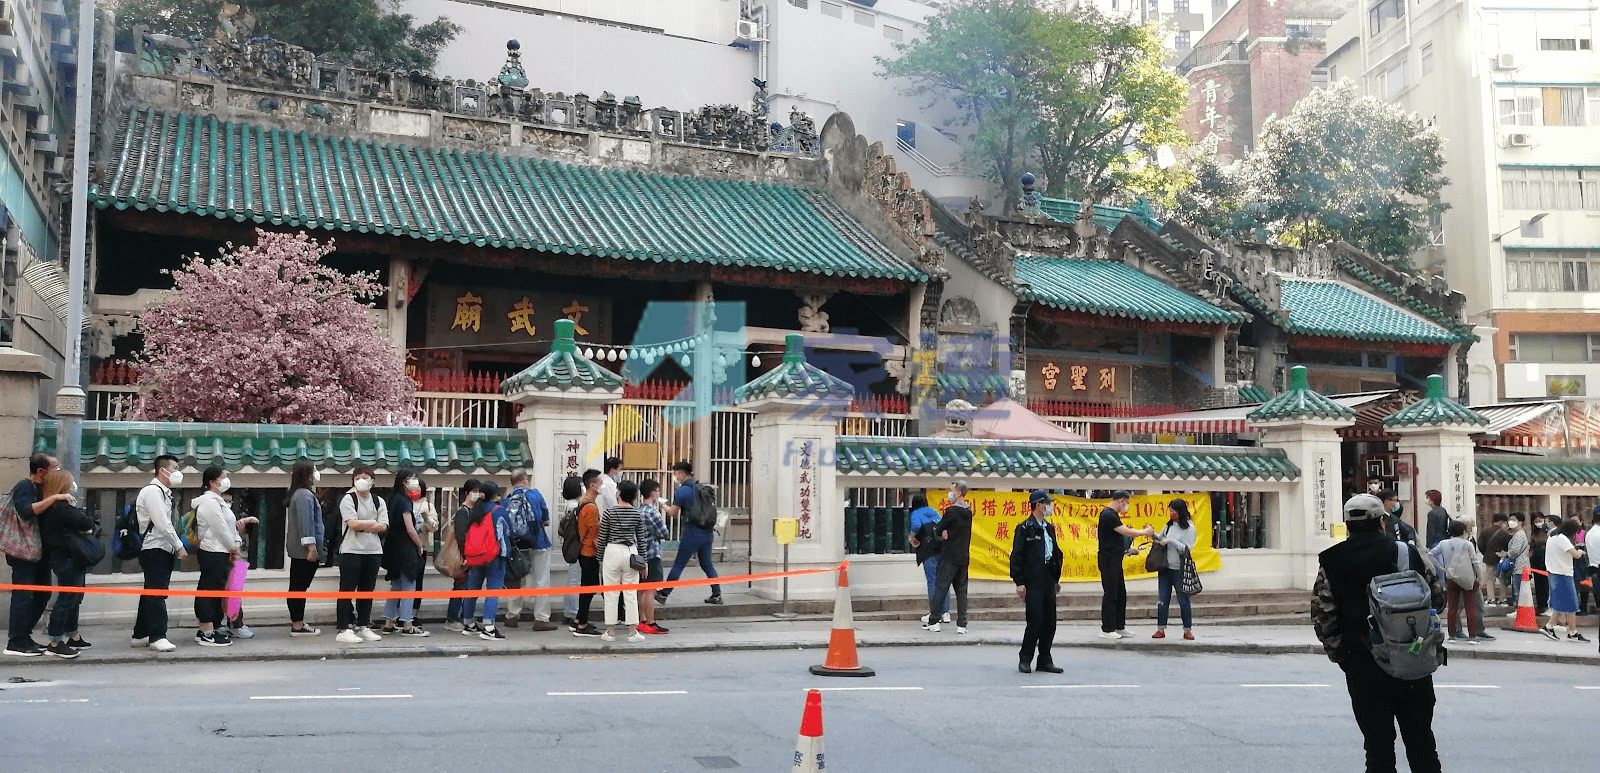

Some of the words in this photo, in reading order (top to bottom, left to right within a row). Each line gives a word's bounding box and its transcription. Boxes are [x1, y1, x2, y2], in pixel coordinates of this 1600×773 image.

[1199, 79, 1224, 154] 青年會
[1041, 362, 1116, 394] 列聖宮
